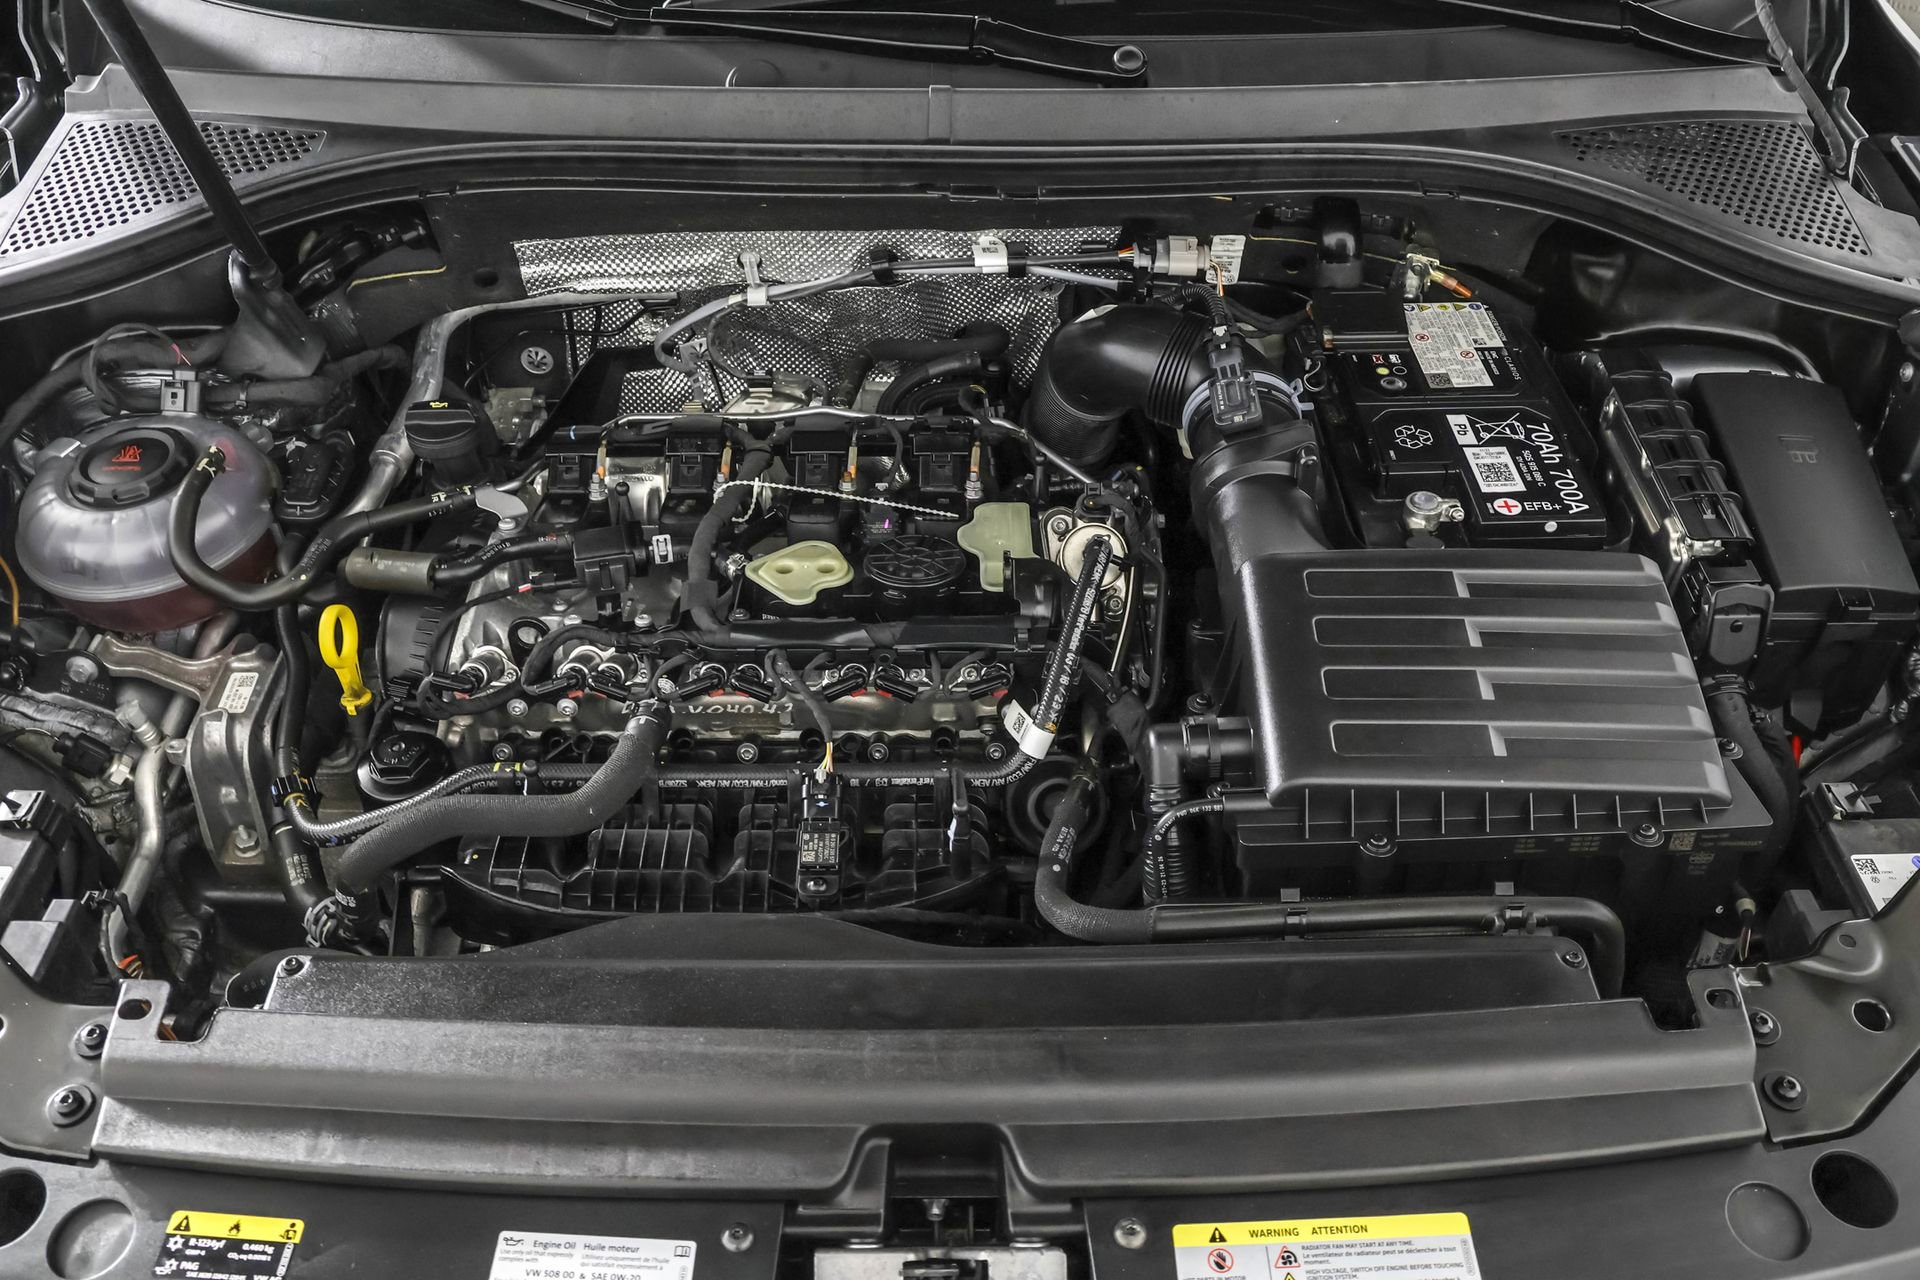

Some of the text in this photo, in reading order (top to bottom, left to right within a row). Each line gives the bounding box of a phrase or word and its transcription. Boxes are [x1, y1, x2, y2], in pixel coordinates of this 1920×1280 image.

[1504, 356, 1521, 380] CLARIOS
[1454, 424, 1469, 436] Pb
[1526, 423, 1590, 514] 70Ah 700A
[1524, 501, 1562, 511] EFB+
[1249, 1225, 1368, 1238] WARNING ATTENTION
[264, 1245, 274, 1254] kg
[533, 1240, 561, 1250] Engine
[584, 1243, 605, 1251] Huile
[608, 1245, 640, 1253] moteur
[180, 1261, 199, 1270] PAG
[544, 1270, 560, 1278] 508
